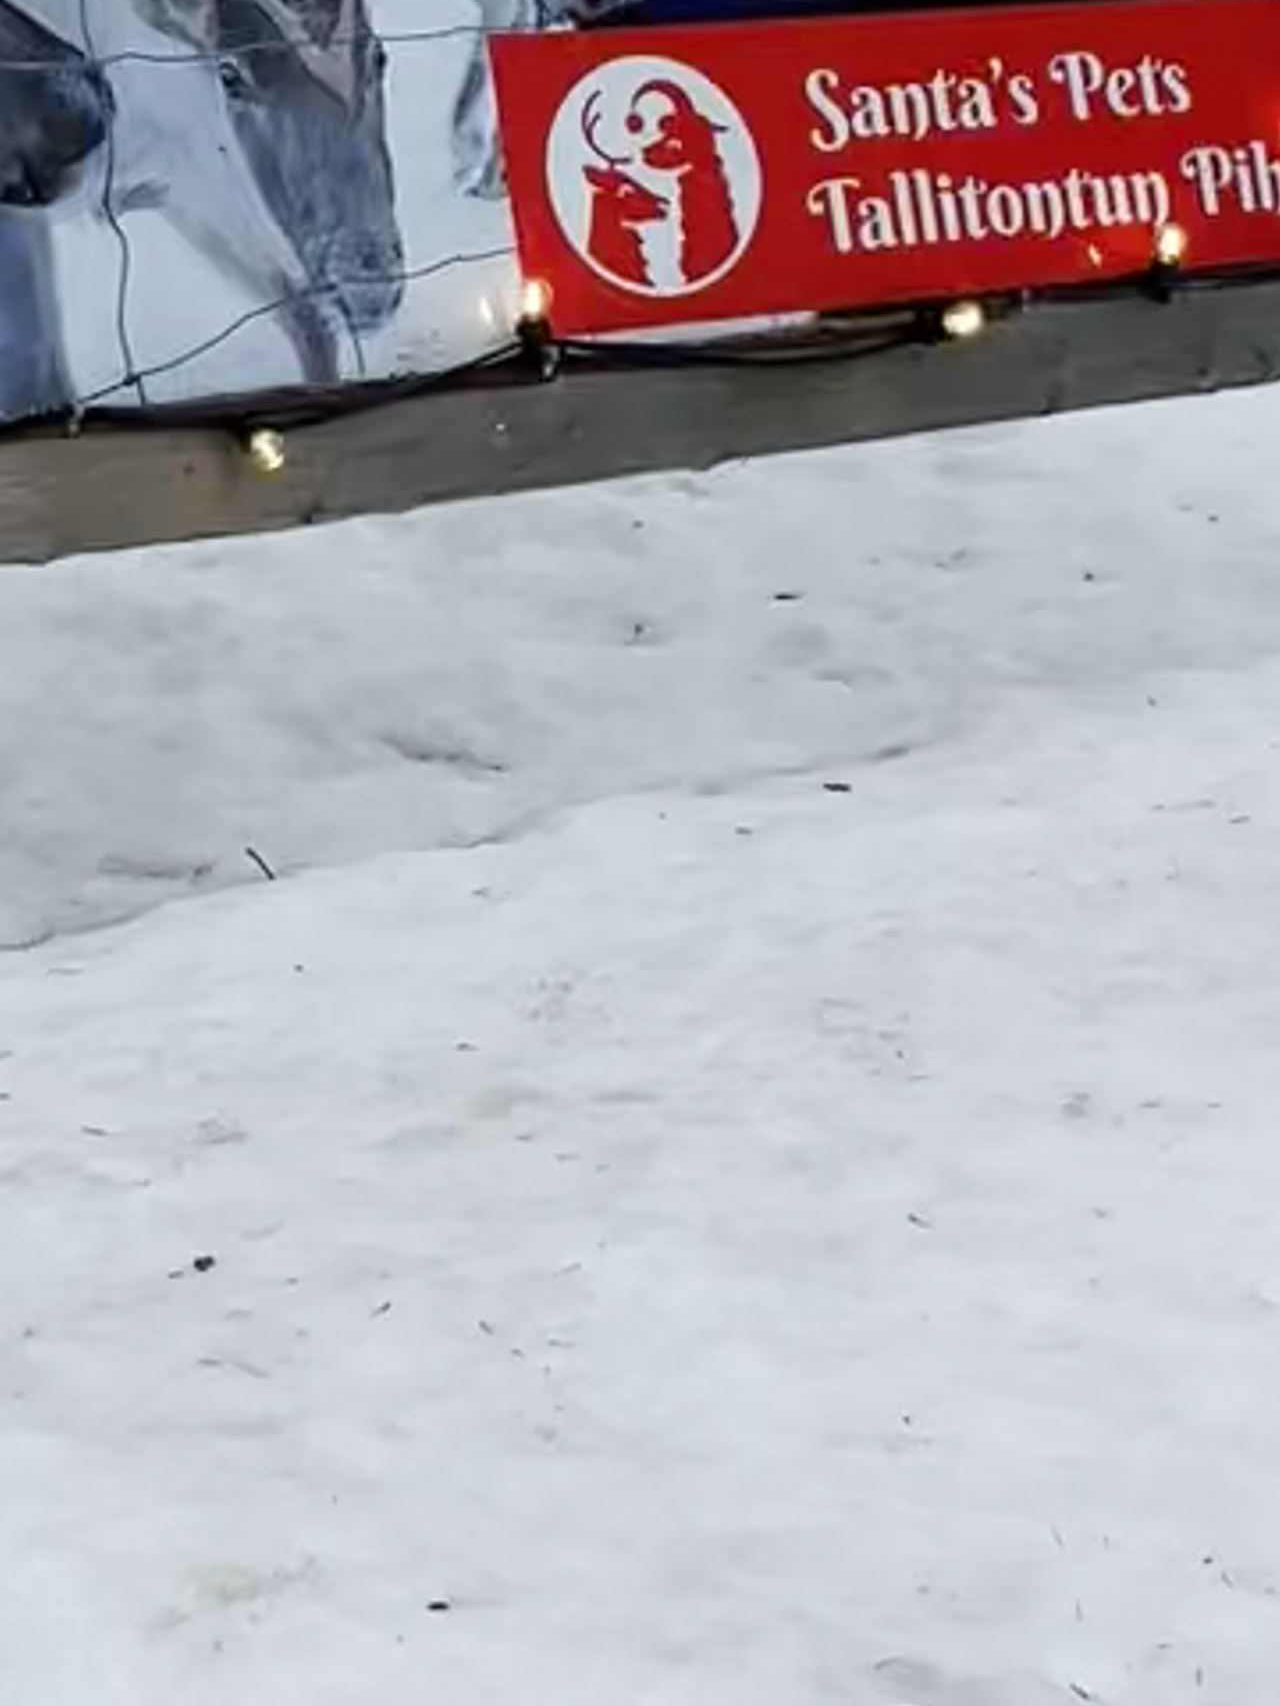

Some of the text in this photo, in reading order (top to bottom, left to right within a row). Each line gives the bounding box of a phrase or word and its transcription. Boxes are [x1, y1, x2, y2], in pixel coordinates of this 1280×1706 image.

[803, 50, 1192, 153] Santa's Pets
[807, 167, 1170, 255] Tallitontun
